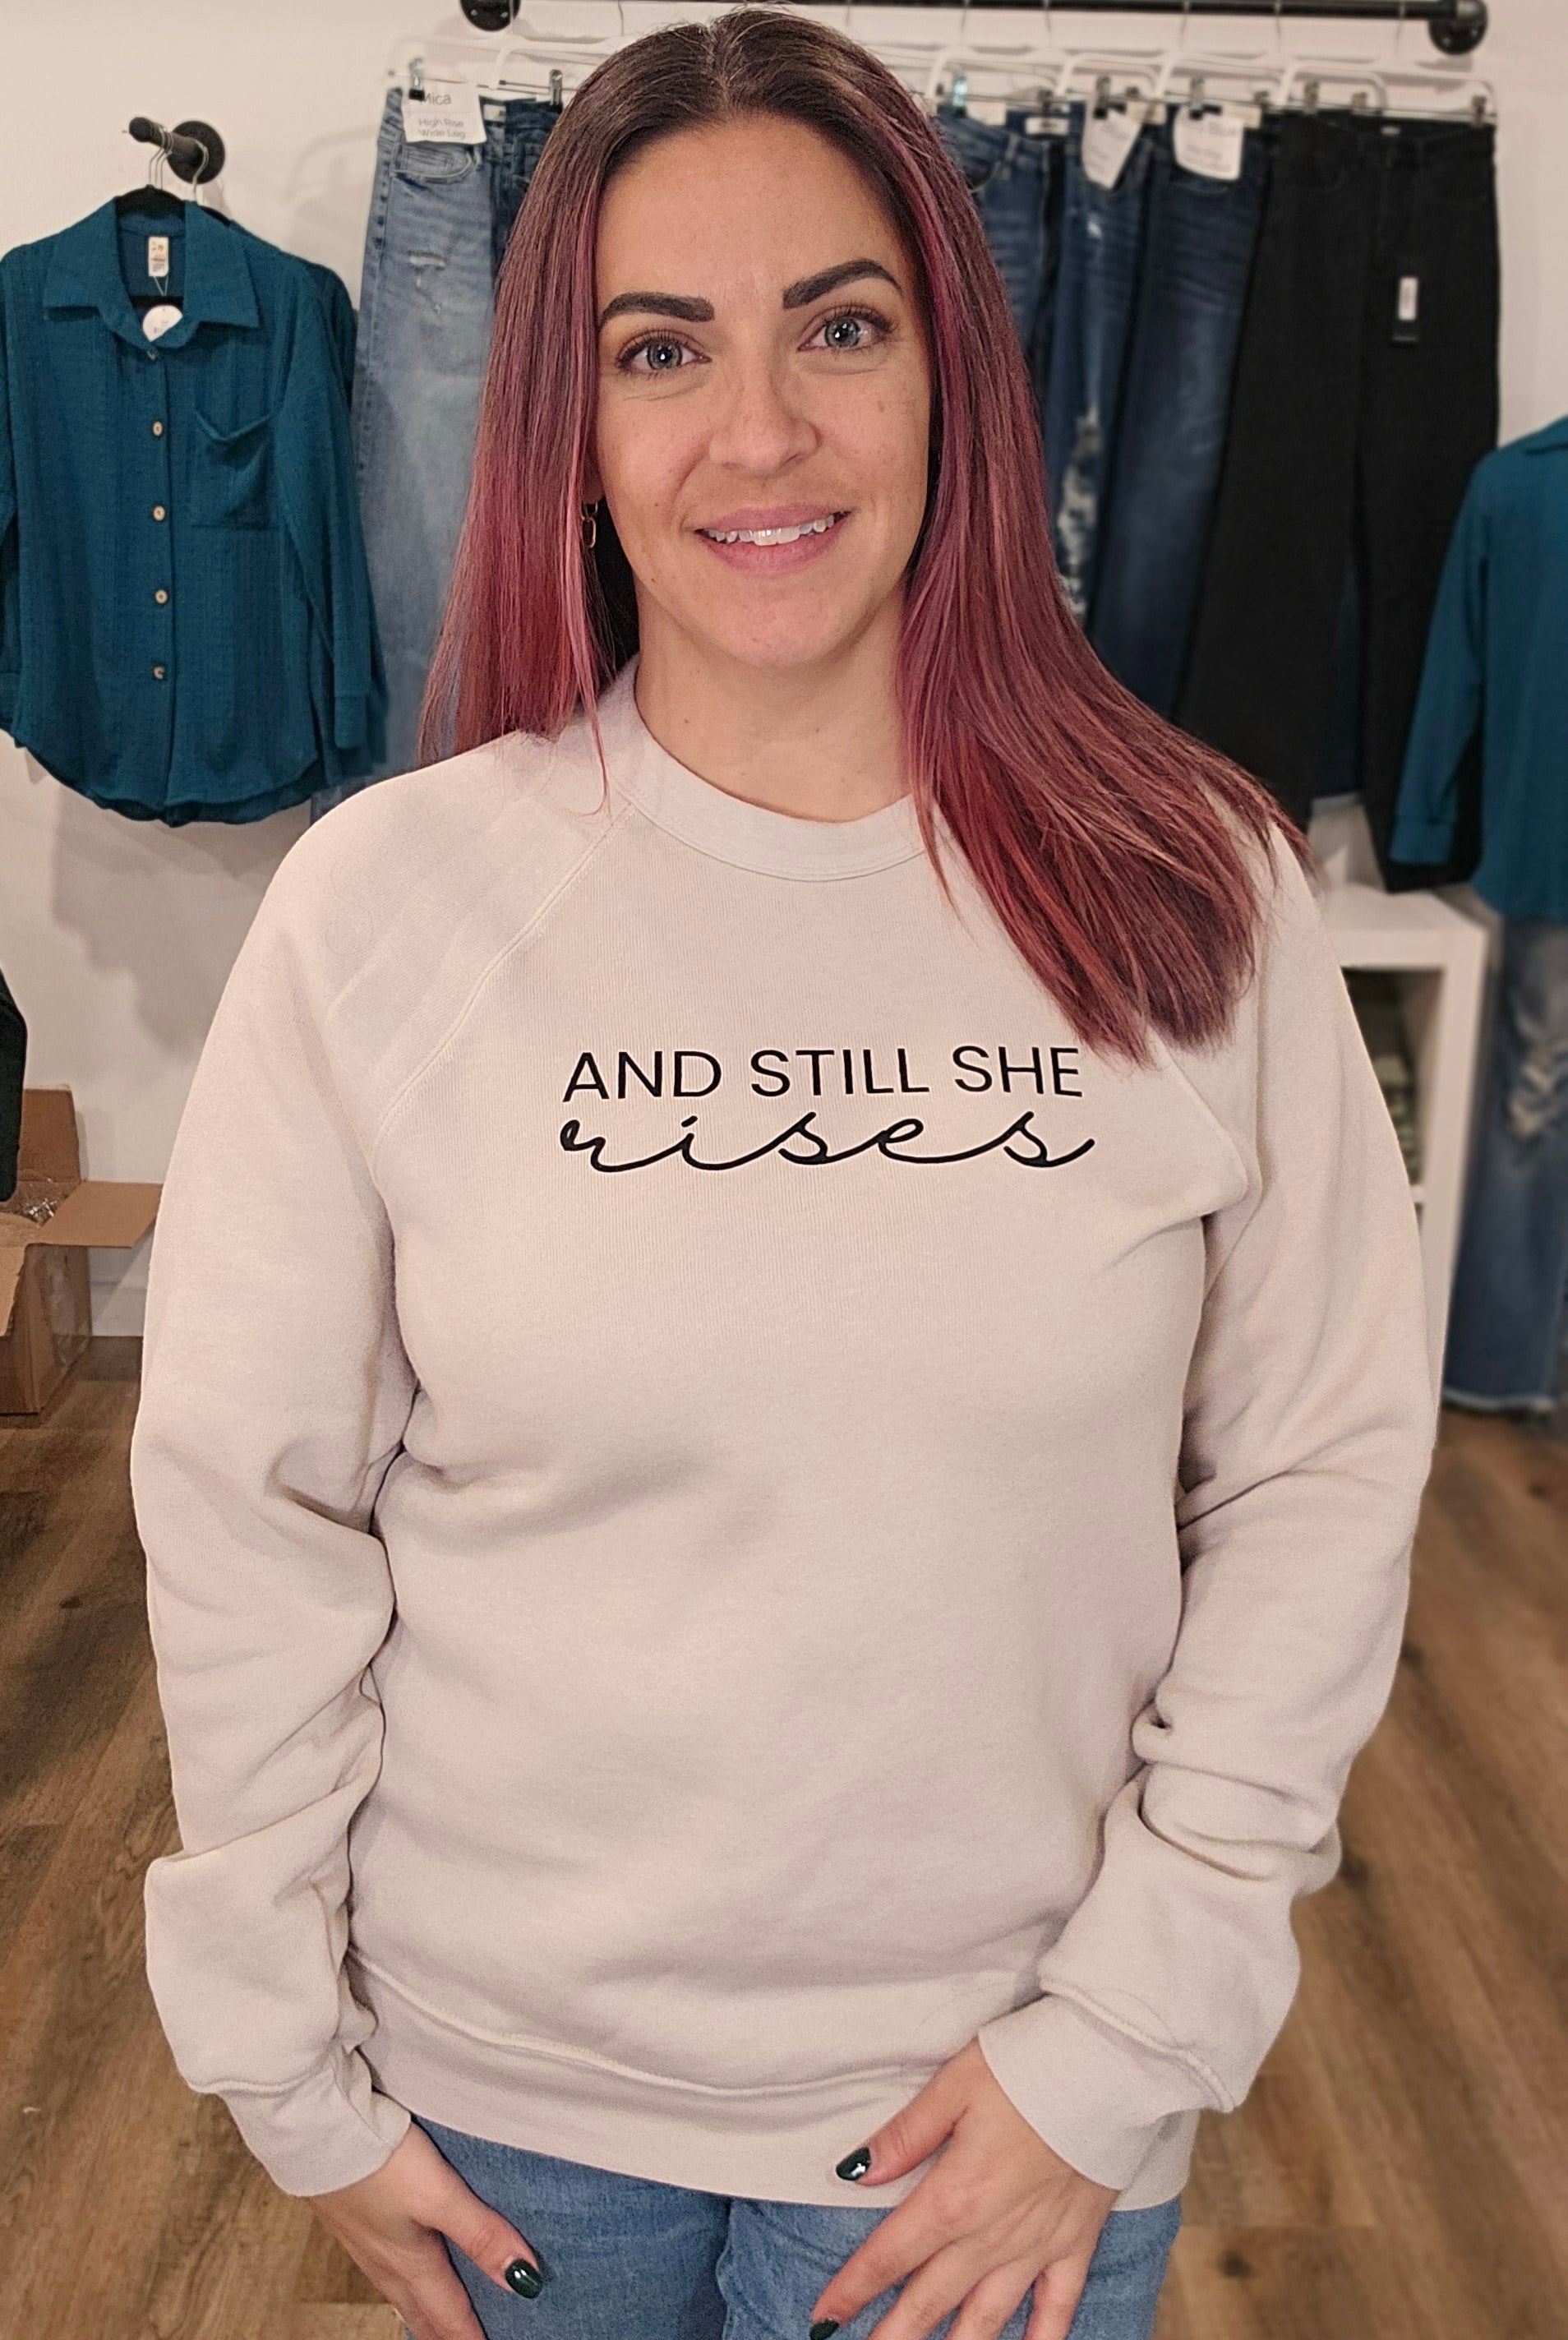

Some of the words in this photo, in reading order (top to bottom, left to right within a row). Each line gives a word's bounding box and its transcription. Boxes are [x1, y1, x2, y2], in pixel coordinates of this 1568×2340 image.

[417, 129, 445, 138] Wide
[447, 130, 466, 140] Leg
[418, 118, 443, 128] High
[562, 1050, 722, 1102] AND
[750, 1048, 930, 1097] STILL
[952, 1045, 1082, 1097] SHE
[560, 1110, 1095, 1173] rises
